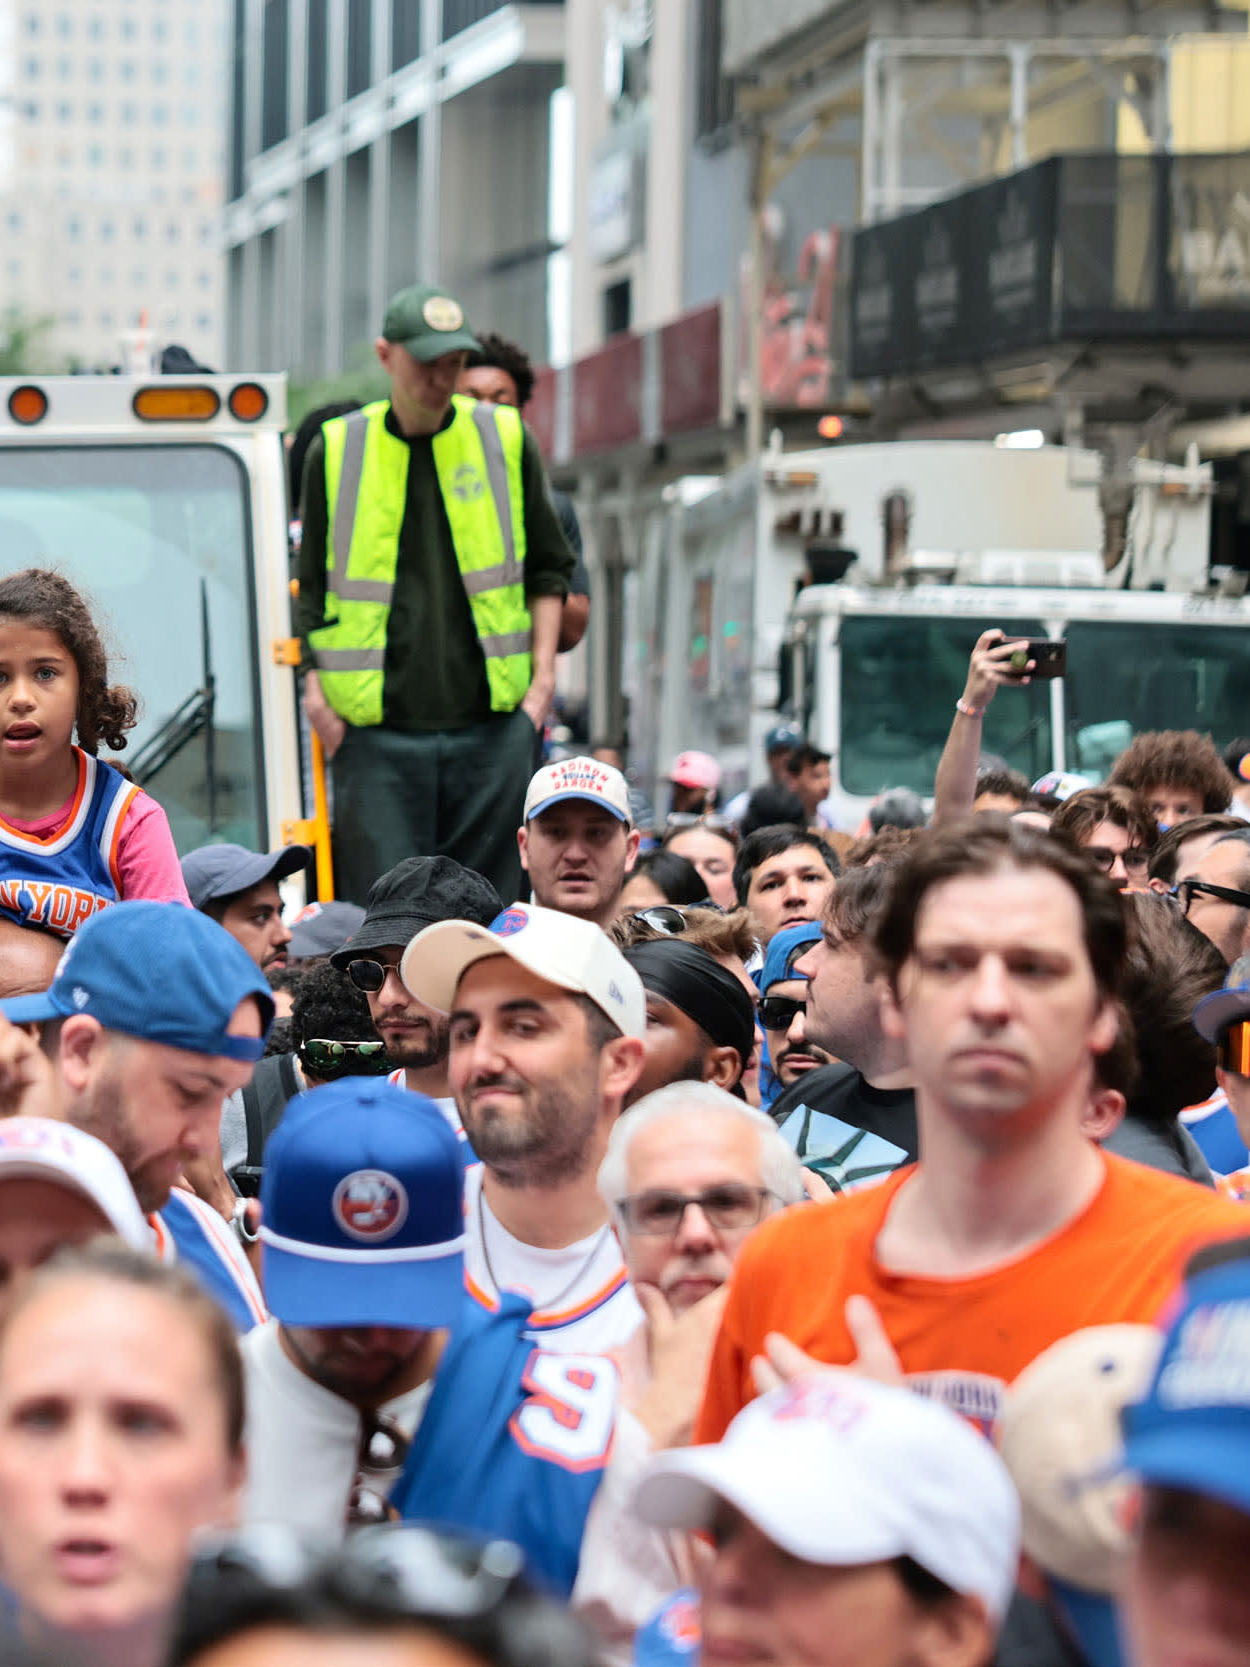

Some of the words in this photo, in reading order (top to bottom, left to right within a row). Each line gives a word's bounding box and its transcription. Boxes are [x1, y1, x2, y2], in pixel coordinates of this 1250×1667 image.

[551, 761, 608, 782] MADISON
[553, 779, 603, 791] GARDEN
[509, 1348, 621, 1474] 9
